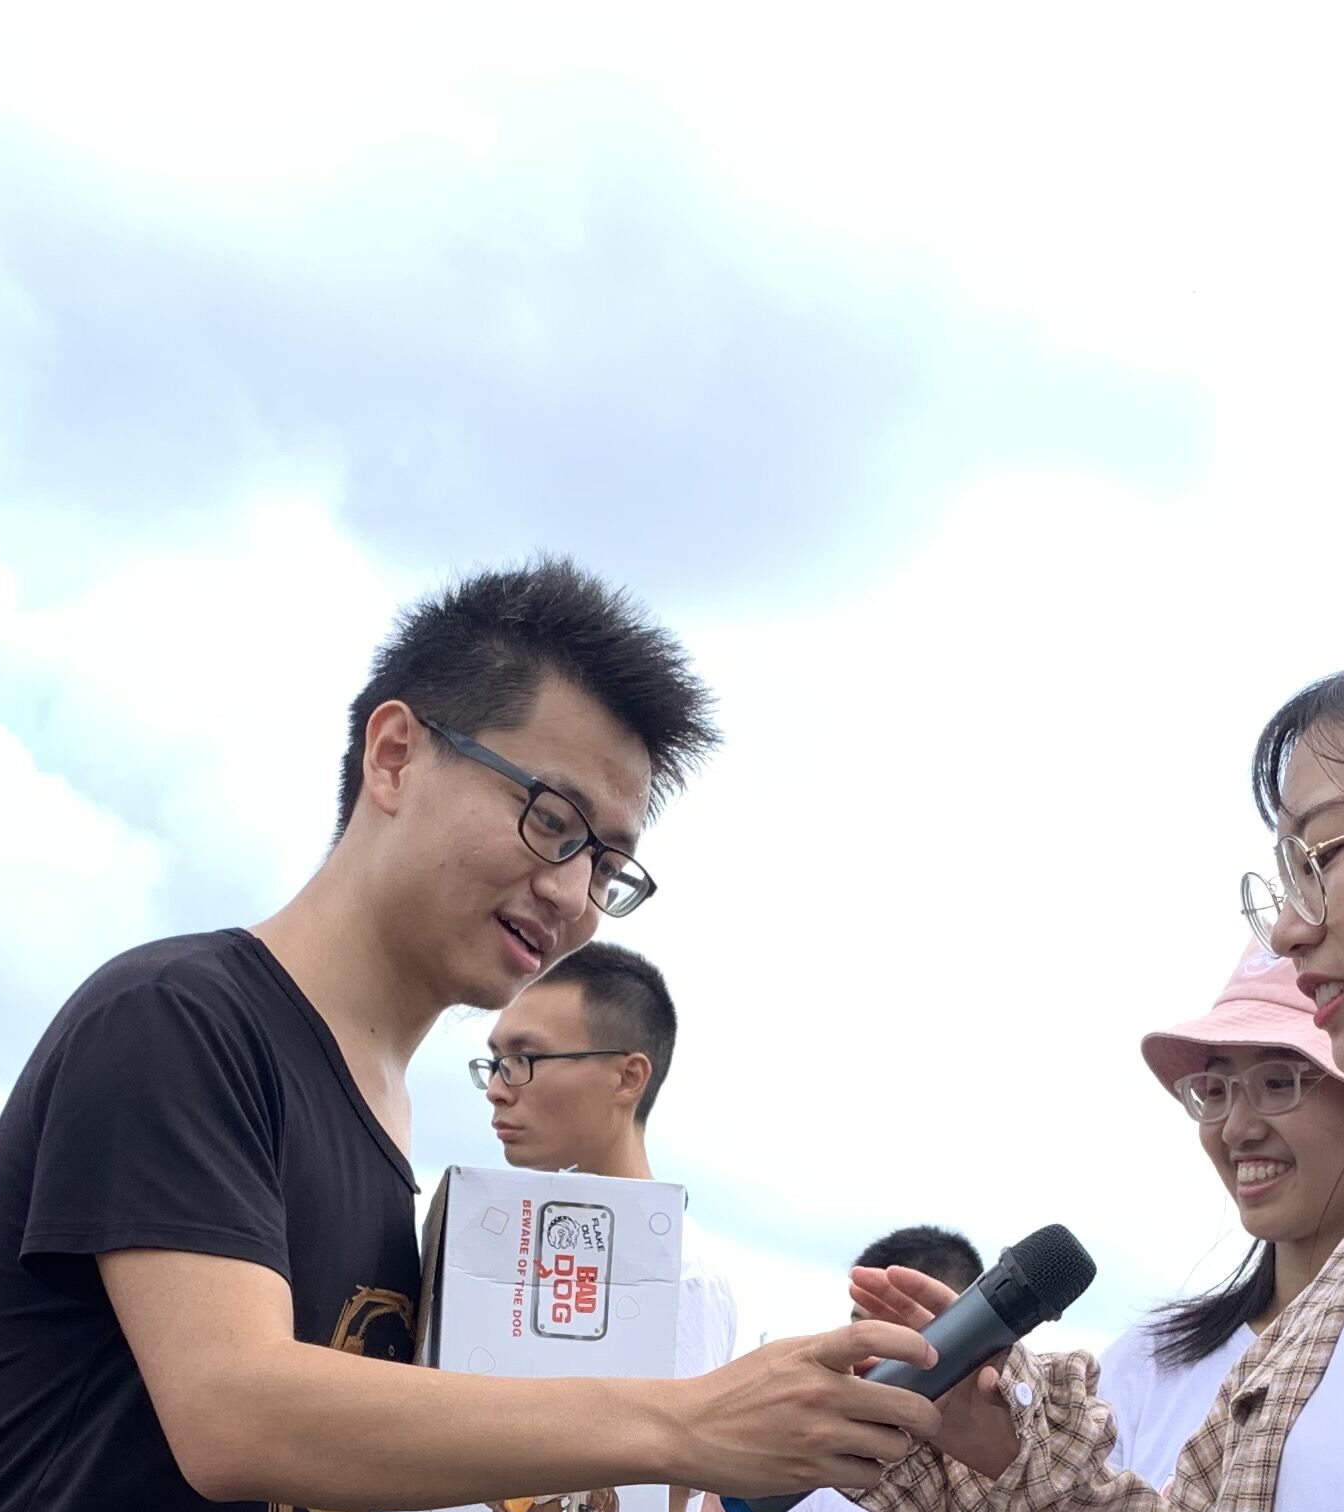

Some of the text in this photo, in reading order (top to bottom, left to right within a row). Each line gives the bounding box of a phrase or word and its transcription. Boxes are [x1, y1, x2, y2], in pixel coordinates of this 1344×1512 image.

[581, 1224, 593, 1250] OUT!
[592, 1217, 605, 1252] FLAKE
[512, 1199, 532, 1337] BEWARE OF THE DOG
[552, 1254, 574, 1323] DOG
[575, 1266, 598, 1313] BAD
